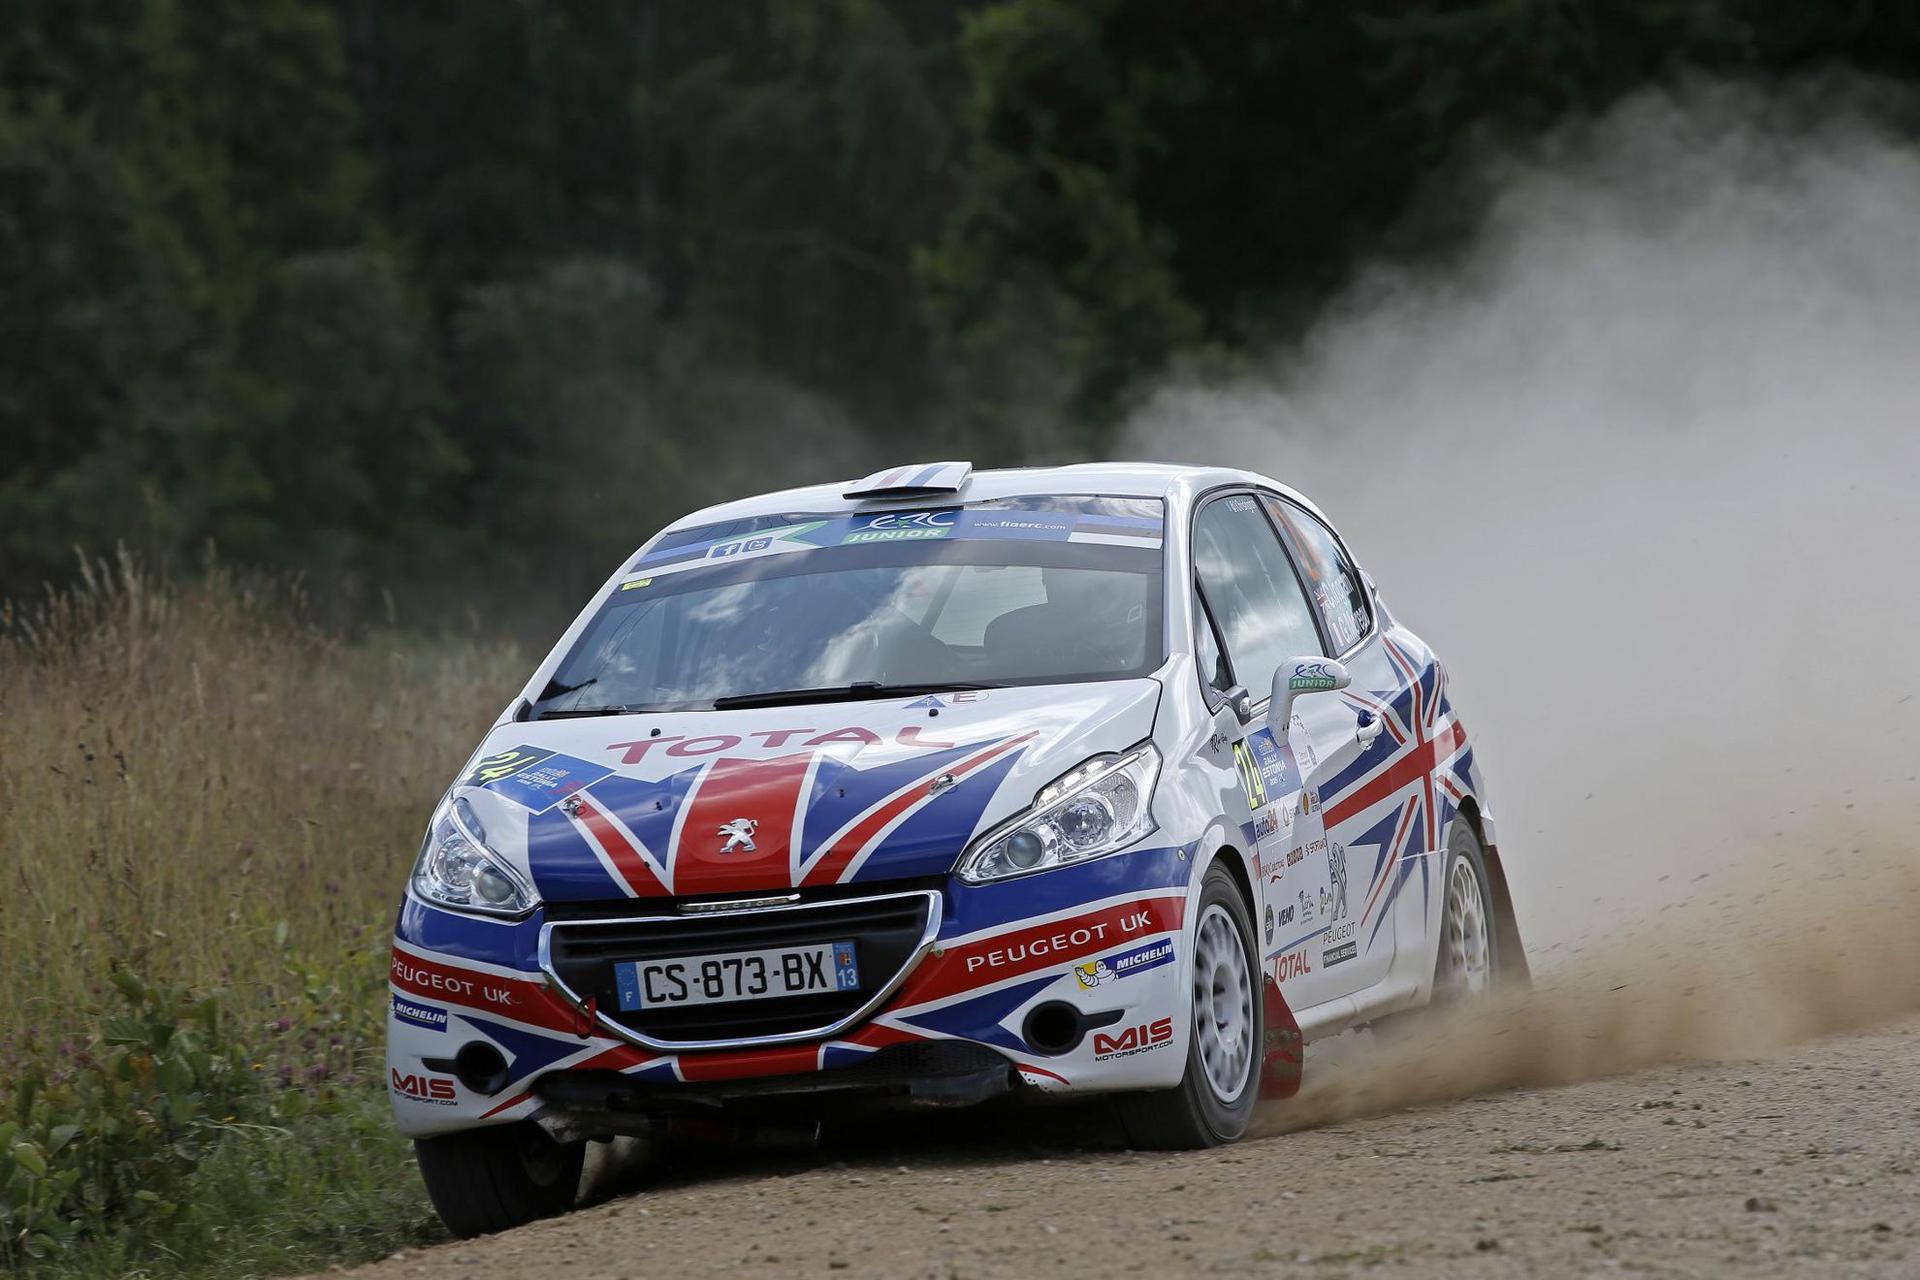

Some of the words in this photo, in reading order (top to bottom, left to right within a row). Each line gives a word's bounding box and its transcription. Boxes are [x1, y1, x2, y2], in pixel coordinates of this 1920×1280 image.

[848, 528, 943, 542] JUNIOR
[974, 520, 1066, 530] www.fiaerc.com
[1293, 679, 1334, 688] JUNIOR
[606, 726, 955, 764] TOTAL
[462, 752, 536, 781] 24
[1234, 738, 1266, 809] 24
[1262, 760, 1287, 778] ESTONIA
[516, 772, 559, 789] ESTONIA
[966, 923, 1108, 972] PEUGEOT
[1120, 910, 1152, 933] UK
[1322, 921, 1356, 944] PEUGEOT
[1116, 944, 1173, 970] MICHELIN
[1271, 949, 1311, 984] TOTAL
[392, 957, 475, 996] PEUGEOT
[484, 986, 511, 1005] UK
[644, 951, 828, 1003] CS-873-BX
[838, 969, 858, 988] 13
[625, 992, 632, 1002] F
[396, 1003, 447, 1023] MICHELIN
[1093, 1016, 1173, 1055] MIS
[1095, 1040, 1174, 1062] MOTORSPORT.COM
[391, 1067, 456, 1099] MIS
